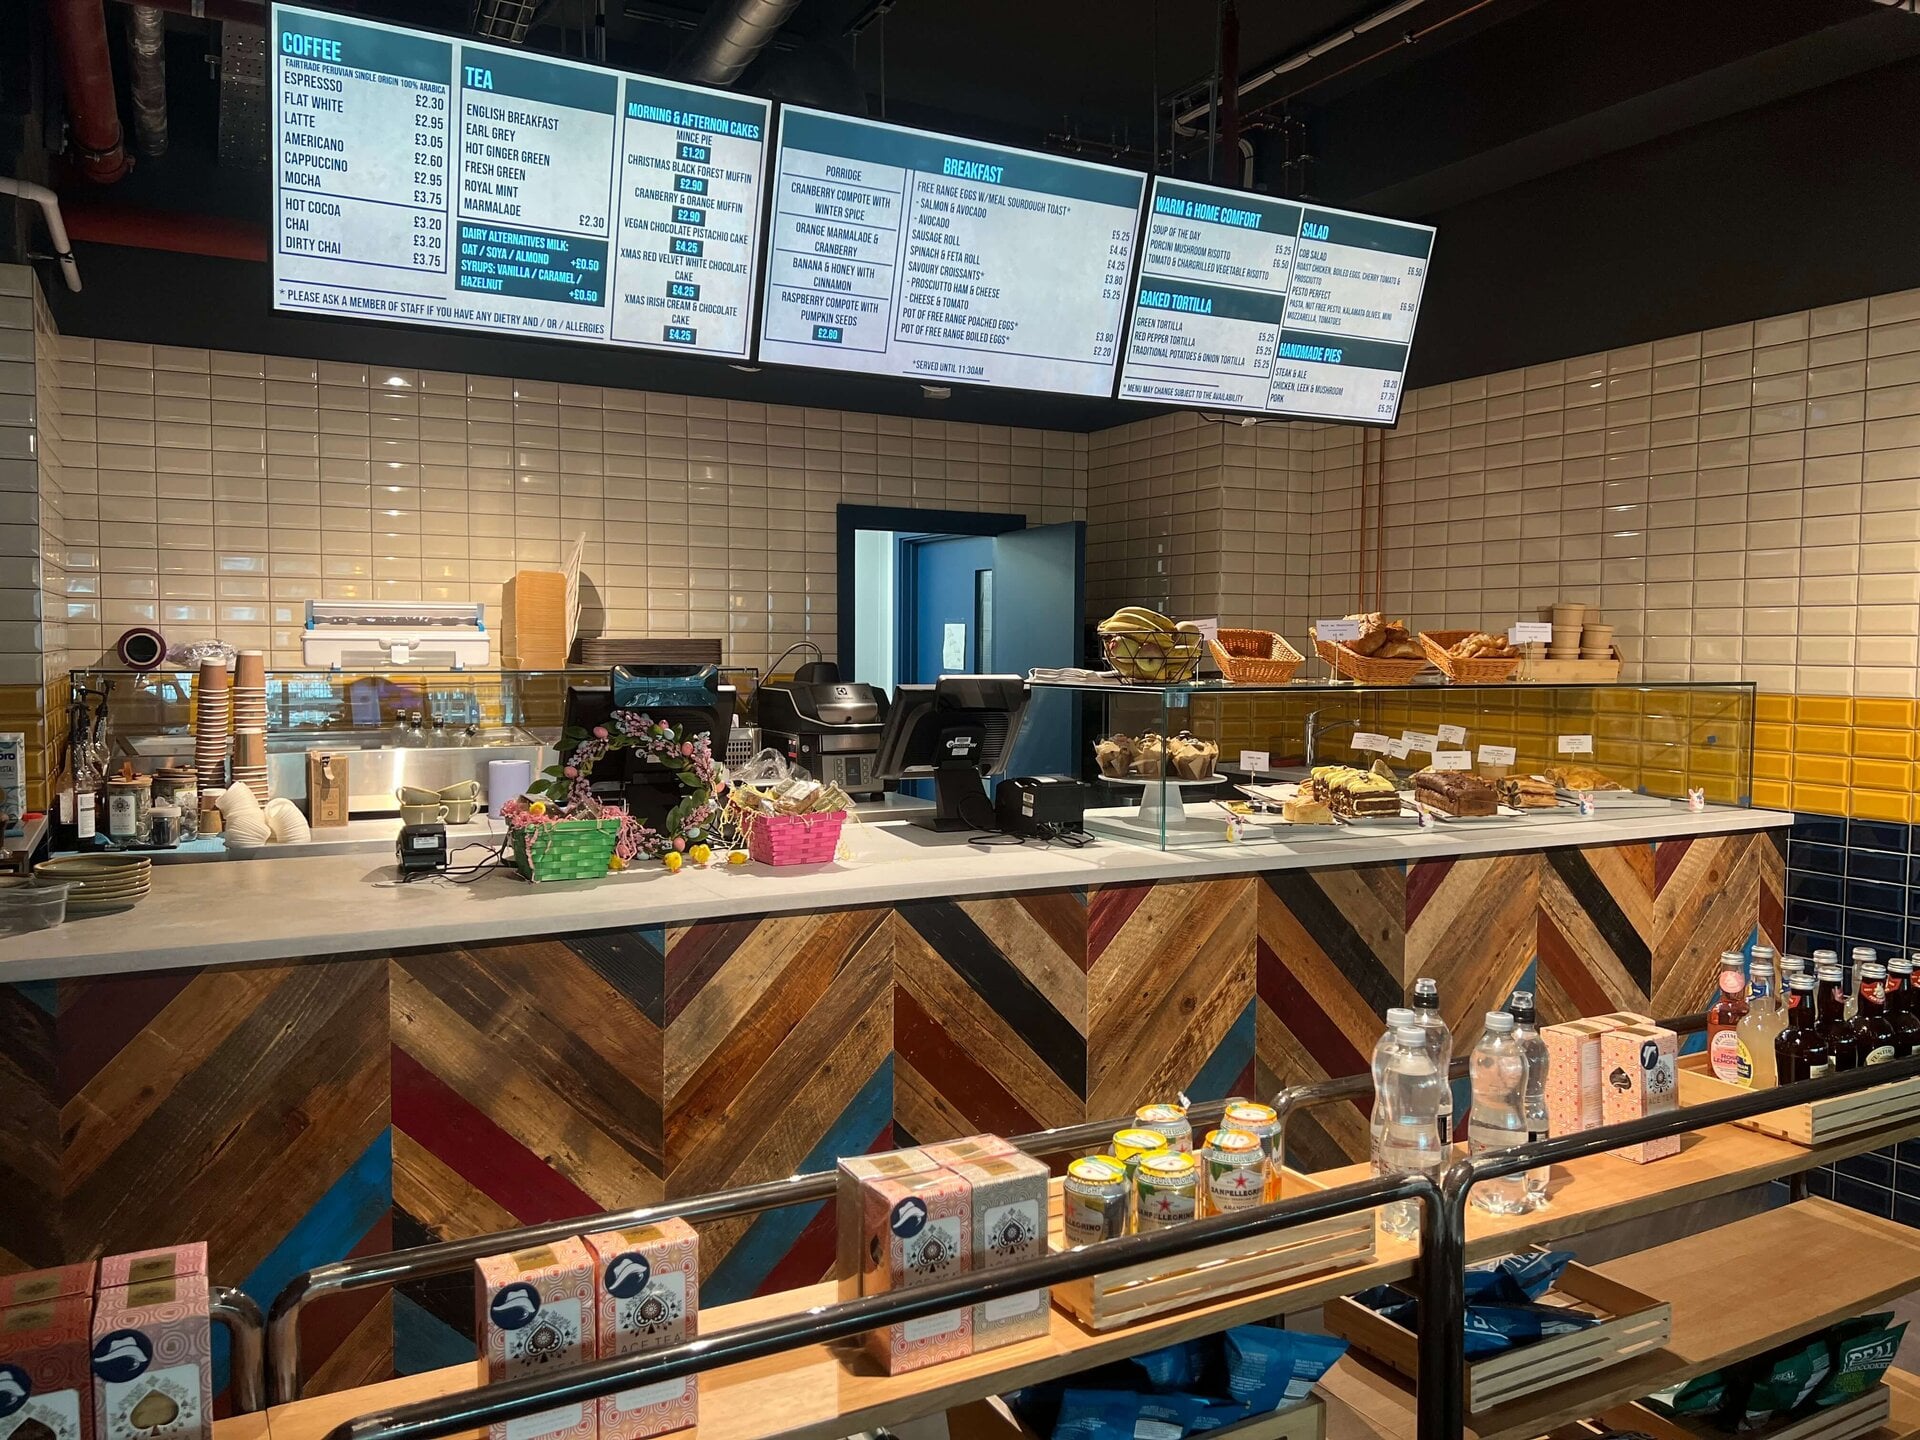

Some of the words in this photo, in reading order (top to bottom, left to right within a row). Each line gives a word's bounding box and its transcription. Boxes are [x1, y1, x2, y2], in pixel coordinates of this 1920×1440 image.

[282, 31, 342, 62] COFFEE
[285, 57, 321, 73] FAIRTRADE
[321, 64, 354, 79] PERUVIAN
[354, 70, 377, 83] SINGLE
[377, 74, 399, 87] ORIGIN
[400, 78, 419, 90] 100%
[419, 82, 446, 95] ARABICA
[464, 66, 493, 90] TEA
[284, 70, 343, 93] ESPRESSSO
[415, 94, 444, 111] £2.30
[284, 90, 309, 108] FLAT
[311, 95, 344, 114] WHITE
[414, 113, 444, 130] £2.95
[466, 102, 506, 122] ENGLISH
[507, 110, 560, 131] BREAKFAST
[628, 102, 672, 124] MORNING
[672, 110, 681, 125] &
[681, 112, 729, 134] AFTERNON
[730, 121, 760, 139] CAKES
[284, 110, 316, 129] LATTE
[414, 132, 443, 149] £3.05
[465, 122, 490, 139] EARL
[491, 126, 516, 143] GREY
[675, 129, 700, 144] MINCE
[700, 133, 713, 146] PIE
[284, 131, 344, 153] AMERICANO
[414, 151, 443, 168] £2.60
[465, 140, 485, 156] HOT
[486, 144, 519, 162] GINGER
[521, 150, 551, 167] GREEN
[682, 145, 706, 161] £1.20
[284, 151, 348, 173] CAPPUCCINO
[413, 171, 443, 187] £2.95
[464, 159, 495, 177] FRESH
[496, 165, 526, 182] GREEN
[627, 153, 671, 171] CHRISTMAS
[671, 160, 696, 175] BLACK
[697, 165, 725, 180] FOREST
[725, 169, 753, 184] MUFFIN
[825, 165, 863, 182] PORRIDGE
[943, 157, 1004, 184] BREAKFAST
[284, 170, 322, 188] MOCHA
[413, 189, 442, 206] £3.75
[464, 178, 494, 195] ROYAL
[495, 183, 519, 199] MINT
[679, 177, 703, 192] £2.90
[790, 181, 836, 200] CRANBERRY
[836, 189, 872, 206] COMPOTE
[872, 195, 891, 209] WITH
[285, 196, 306, 212] HOT
[308, 200, 341, 217] COCOA
[413, 215, 442, 231] £3.20
[463, 197, 522, 217] MARMALADE
[578, 214, 605, 229] £2.30
[814, 202, 844, 218] WINTER
[843, 207, 866, 222] SPICE
[1155, 195, 1186, 216] WARM
[1185, 201, 1193, 218] &
[1193, 202, 1221, 222] HOME
[1219, 207, 1263, 229] COMFORT
[285, 216, 309, 232] CHAI
[413, 234, 442, 249] £3.20
[462, 226, 488, 241] DAIRY
[488, 230, 546, 249] ALTERNATIVES
[546, 237, 569, 252] MILK:
[624, 216, 649, 231] VEGAN
[649, 220, 692, 237] CHOCOLATE
[692, 227, 729, 242] PISTACHIO
[729, 232, 749, 246] CAKE
[1152, 224, 1169, 236] SOUP
[1168, 226, 1177, 237] OF
[1177, 228, 1190, 240] THE
[1188, 230, 1202, 241] DAY
[1301, 221, 1330, 241] SALAD
[285, 235, 316, 251] DIRTY
[317, 239, 341, 255] CHAI
[412, 252, 441, 267] £3.75
[675, 239, 698, 254] £4.25
[814, 241, 858, 258] CRANBERRY
[911, 228, 943, 245] SAUSAGE
[943, 233, 961, 247] ROLL
[1106, 259, 1126, 272] £4.25
[1309, 249, 1328, 262] SALAD
[620, 247, 642, 260] XMAS
[642, 250, 658, 263] RED
[658, 252, 685, 266] VELVET
[685, 256, 708, 270] WHITE
[708, 259, 748, 275] CHOCOLATE
[909, 244, 940, 260] SPINACH
[940, 249, 946, 261] &
[946, 249, 963, 264] FETA
[963, 252, 981, 266] ROLL
[1104, 273, 1124, 286] £3.80
[460, 274, 504, 291] HAZELNUT
[568, 288, 598, 302] +£0.50
[674, 270, 694, 283] CAKE
[671, 284, 695, 298] £4.25
[1139, 289, 1171, 308] BAKED
[1171, 293, 1212, 314] TORTILLA
[1291, 285, 1309, 297] PESTO
[1308, 288, 1332, 300] PERFECT
[287, 289, 321, 304] PLEASE
[321, 293, 340, 306] ASK
[341, 295, 348, 307] A
[349, 296, 387, 311] MEMBER
[387, 300, 399, 312] OF
[400, 302, 425, 315] STAFF
[426, 304, 435, 316] IF
[436, 305, 452, 318] YOU
[453, 307, 475, 321] HAVE
[475, 310, 493, 322] ANY
[493, 312, 521, 325] DIETRY
[522, 315, 539, 327] AND
[546, 318, 558, 329] OR
[565, 320, 605, 335] ALLERGIES
[800, 309, 834, 324] PUMPKIN
[834, 313, 858, 327] SEEDS
[1136, 316, 1157, 329] GREEN
[1156, 318, 1183, 333] TORTILLA
[1133, 330, 1147, 342] RED
[1146, 331, 1170, 345] PEPPER
[1169, 334, 1196, 348] TORTILLA
[1278, 342, 1325, 361] HANDMADE
[1323, 347, 1343, 364] PIES
[1269, 393, 1285, 403] PORK
[1849, 1342, 1894, 1366] REAL
